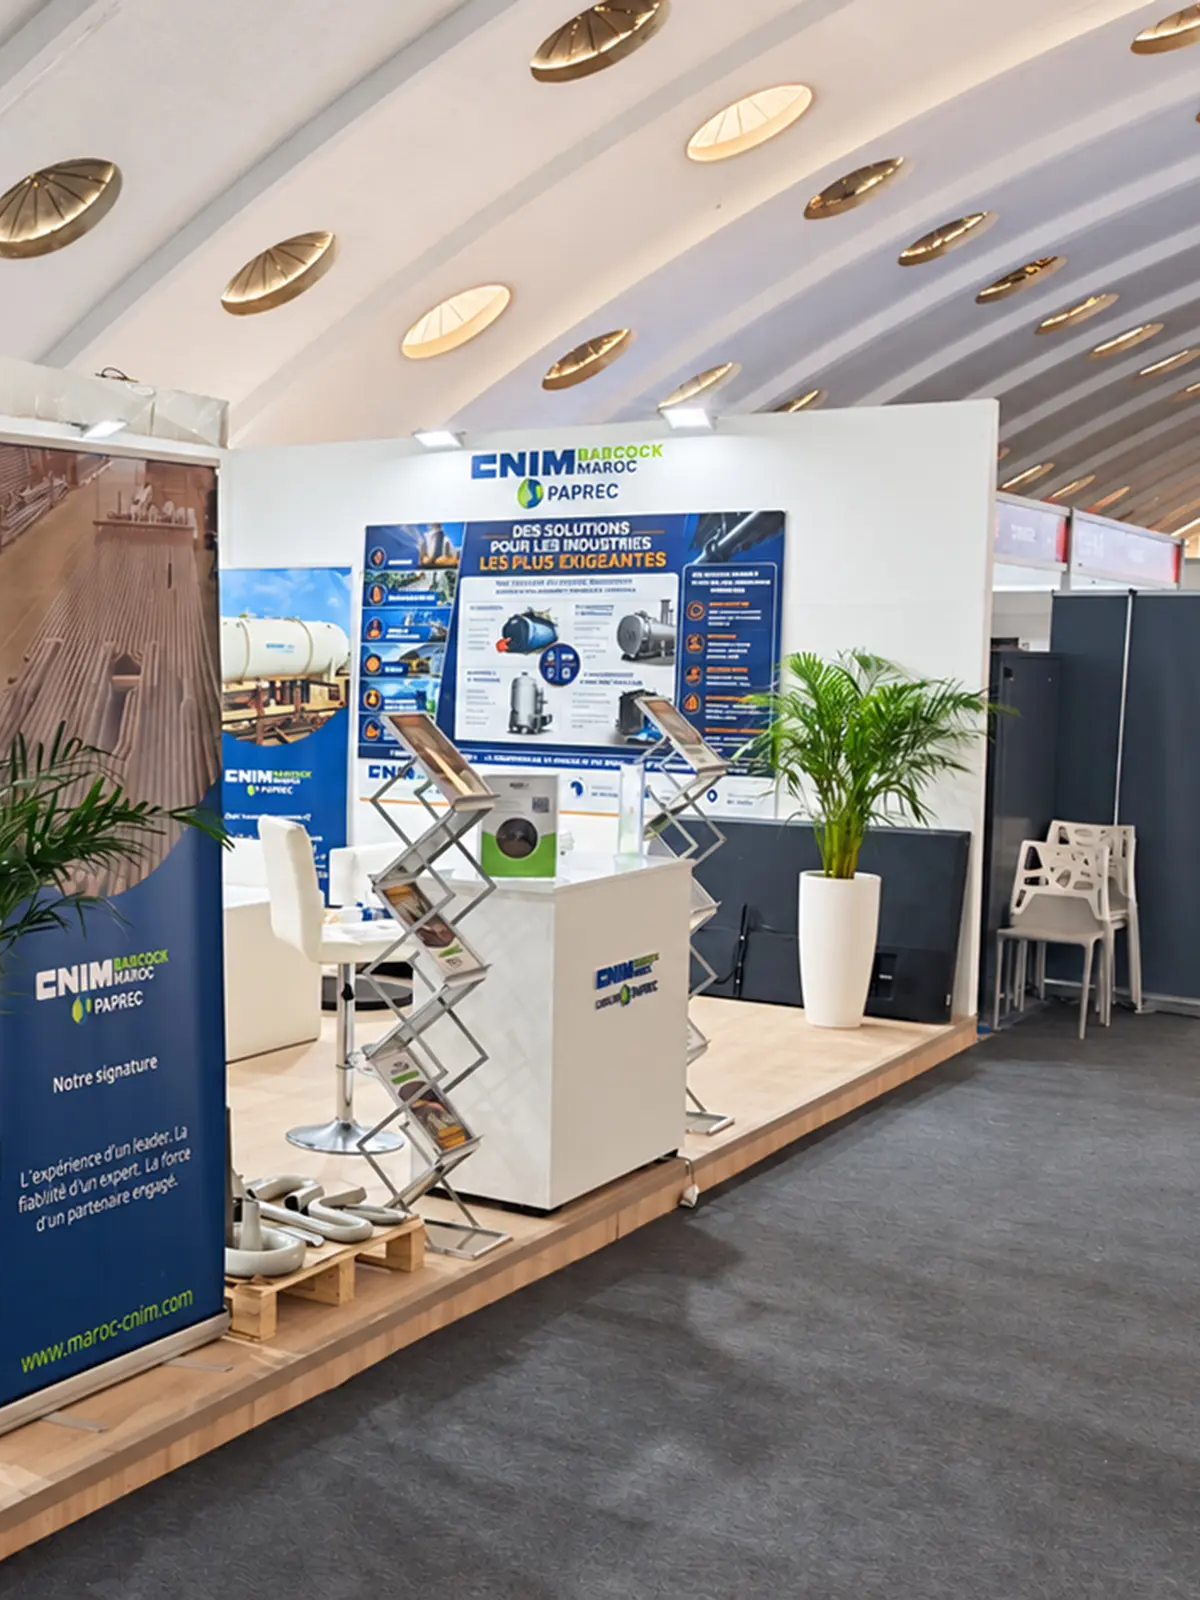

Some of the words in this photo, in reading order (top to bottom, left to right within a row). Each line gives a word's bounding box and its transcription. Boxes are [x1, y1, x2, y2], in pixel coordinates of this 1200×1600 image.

[471, 449, 575, 480] CNIM
[577, 444, 663, 461] BABCOCK
[577, 460, 637, 475] MAROC
[548, 483, 619, 501] PAPREC
[512, 523, 541, 538] DES
[544, 521, 630, 537] SOLUTIONS
[490, 539, 530, 553] POUR
[533, 538, 559, 553] LES
[563, 536, 652, 552] INDUSTRIES
[479, 555, 508, 571] LES
[512, 554, 554, 570] PLUS
[559, 552, 667, 569] EXIGEANTES
[224, 769, 272, 784] CNIM
[36, 959, 113, 1001] CNIM
[114, 949, 169, 970] BABCOCK
[113, 966, 154, 985] MAROC
[94, 990, 143, 1014] PAPREC
[53, 1072, 93, 1094] Notre
[96, 1056, 158, 1084] signature
[20, 1152, 102, 1188] L'expérience
[104, 1143, 131, 1162] d'un
[132, 1130, 173, 1153] leader.
[175, 1125, 188, 1141] La
[69, 1176, 97, 1197] d'un
[99, 1163, 142, 1190] expert.
[145, 1157, 159, 1173] La
[161, 1147, 191, 1168] force
[36, 1211, 65, 1232] d'un
[67, 1190, 130, 1225] partenaire
[132, 1173, 178, 1200] engagé.
[20, 1289, 194, 1374] www.maroc-cnim.com
